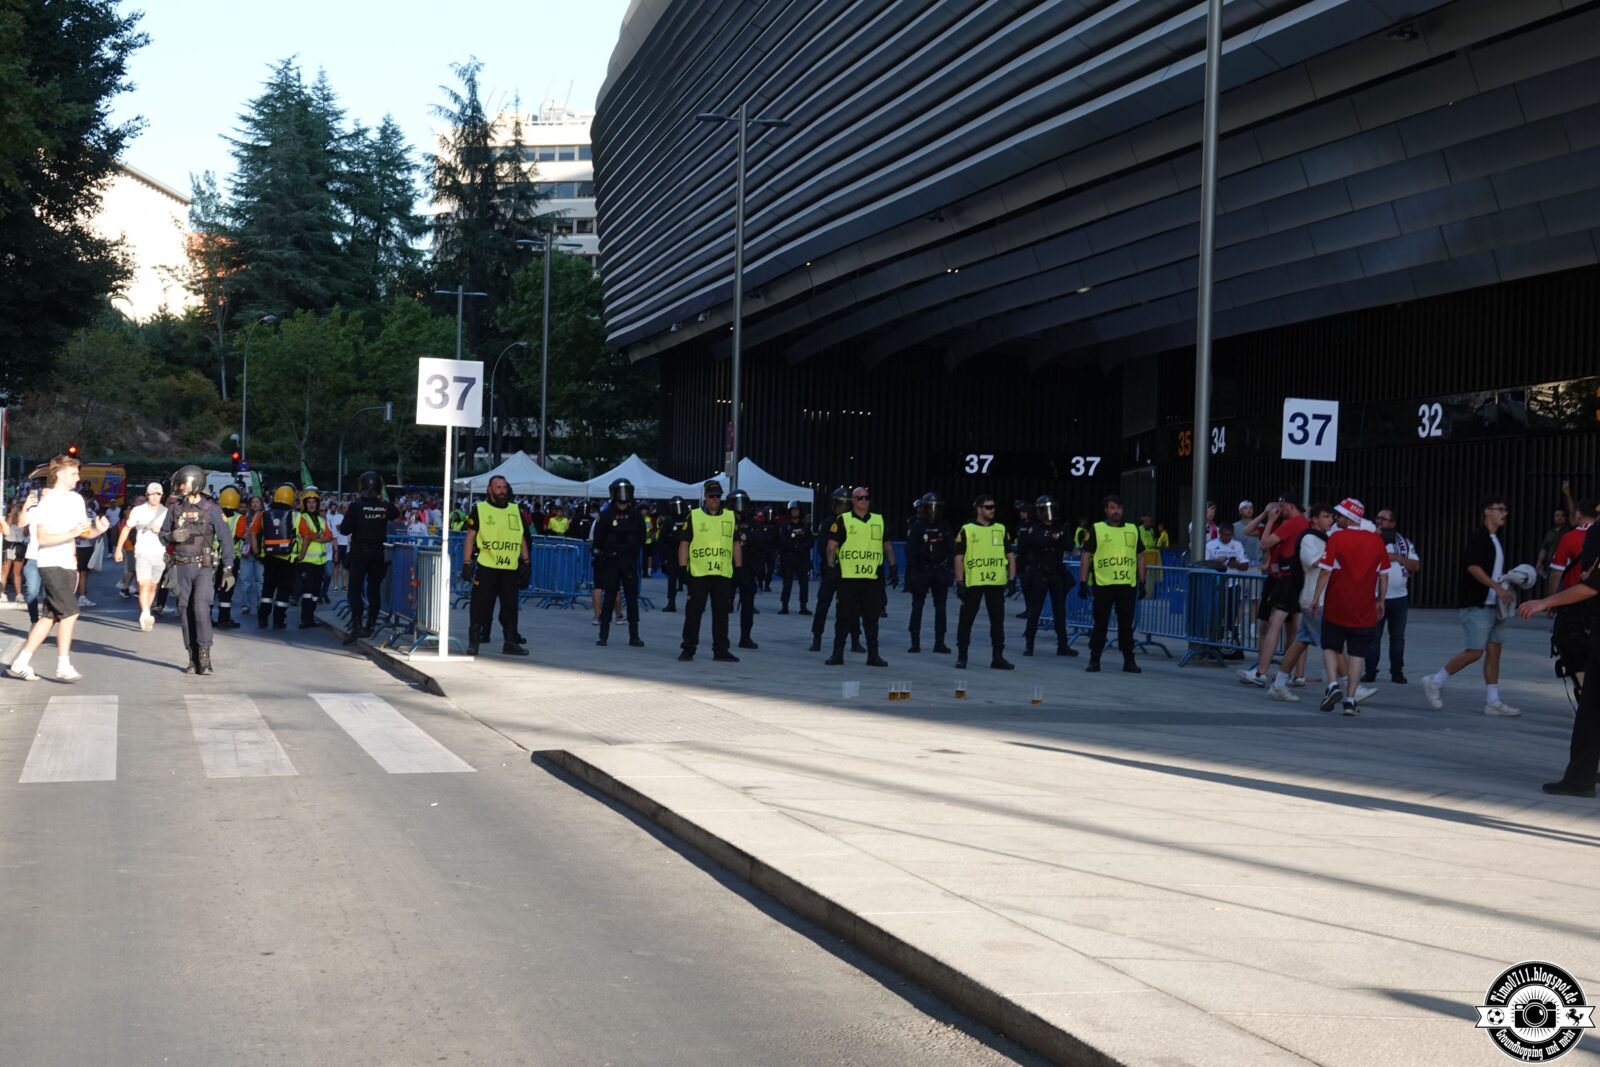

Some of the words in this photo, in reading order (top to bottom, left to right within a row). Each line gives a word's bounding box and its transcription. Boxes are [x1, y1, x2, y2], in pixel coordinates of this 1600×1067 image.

[424, 374, 477, 411] 37
[1417, 402, 1443, 438] 32
[1288, 412, 1332, 446] 37
[1178, 430, 1192, 457] 35
[1211, 426, 1226, 454] 34
[965, 454, 994, 474] 37
[1070, 456, 1101, 476] 37
[481, 540, 521, 551] SECURIT
[692, 547, 732, 560] SECURIT
[840, 550, 882, 561] SECURIT
[707, 561, 723, 572] 14
[854, 564, 873, 575] 160
[967, 558, 1004, 570] SECURIT
[980, 571, 997, 582] 142
